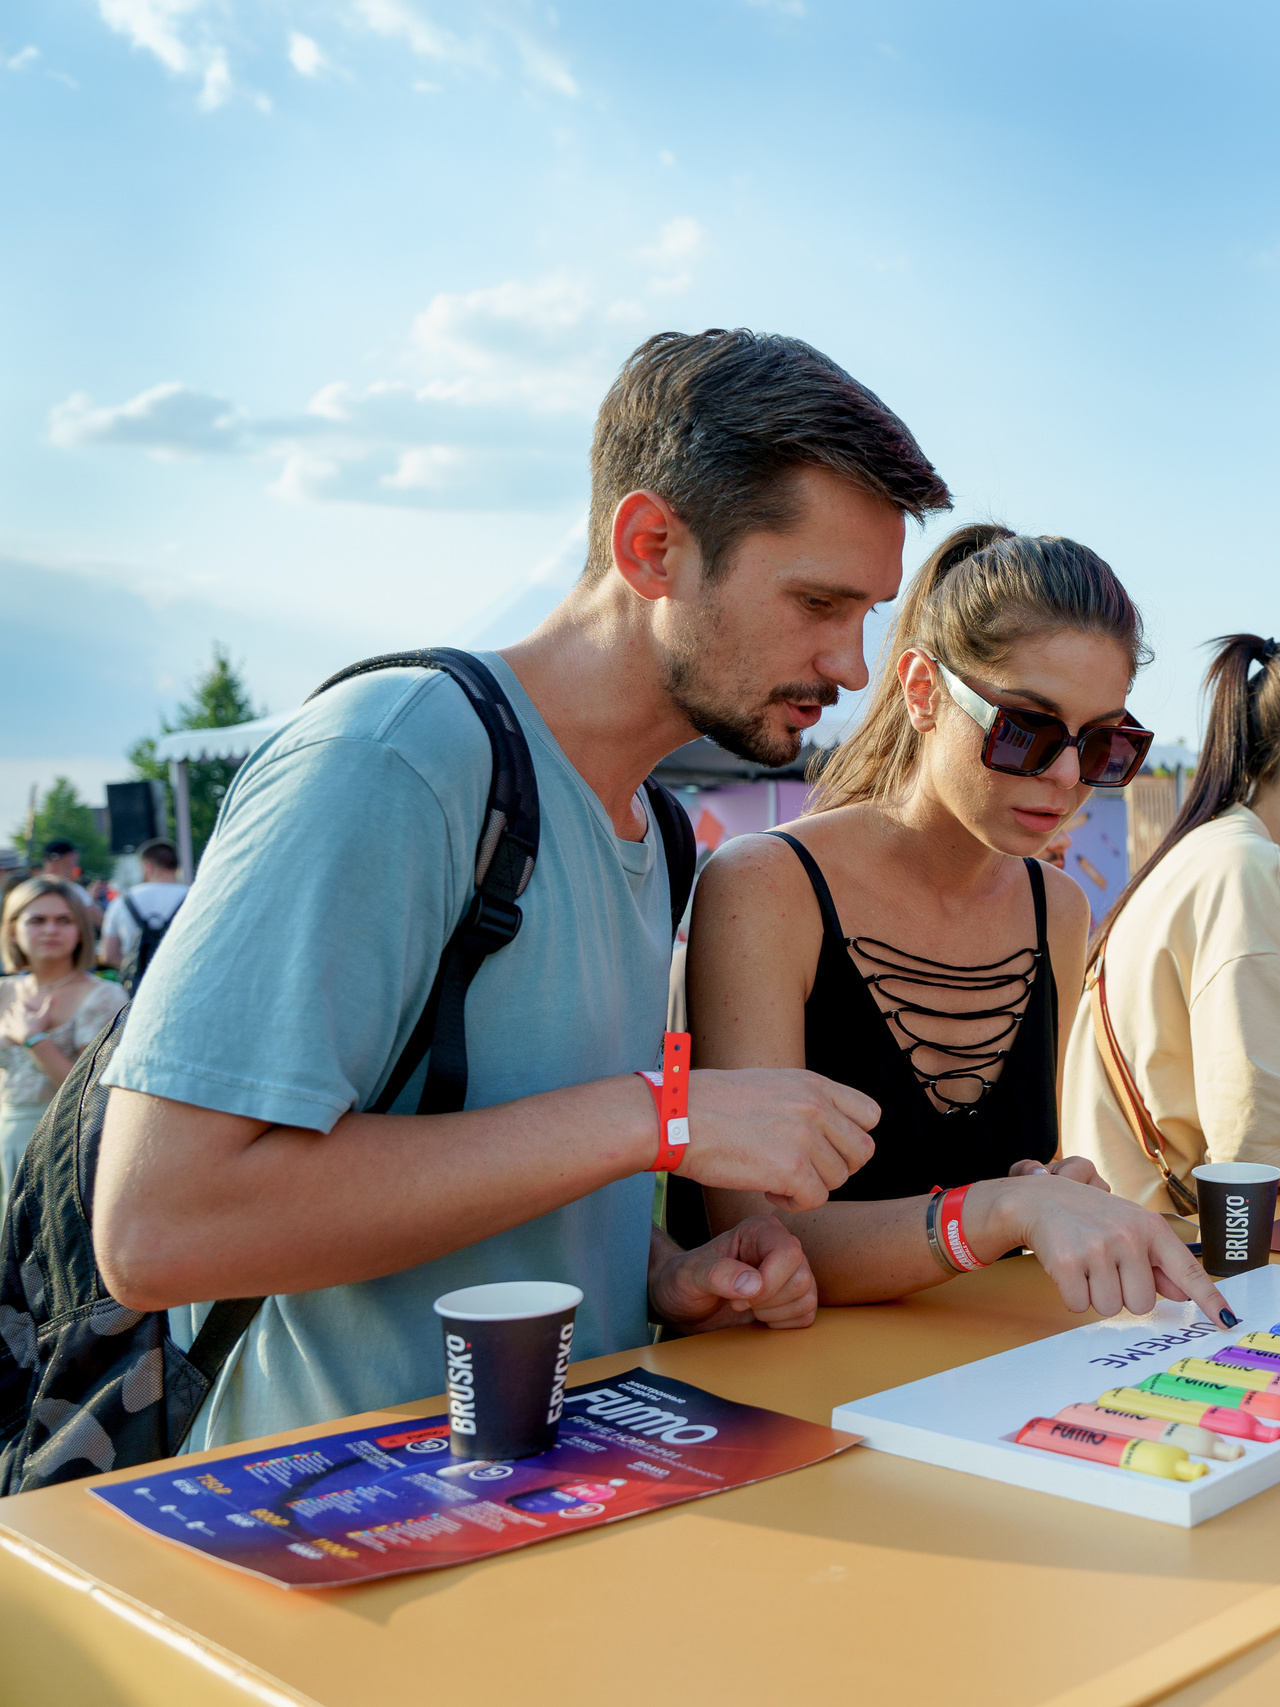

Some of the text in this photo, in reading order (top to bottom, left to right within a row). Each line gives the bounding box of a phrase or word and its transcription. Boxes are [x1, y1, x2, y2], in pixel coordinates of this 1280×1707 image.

[1225, 1195, 1249, 1261] BRUSKO
[1089, 1319, 1243, 1368] UPREME
[446, 1334, 477, 1436] BRUSKO
